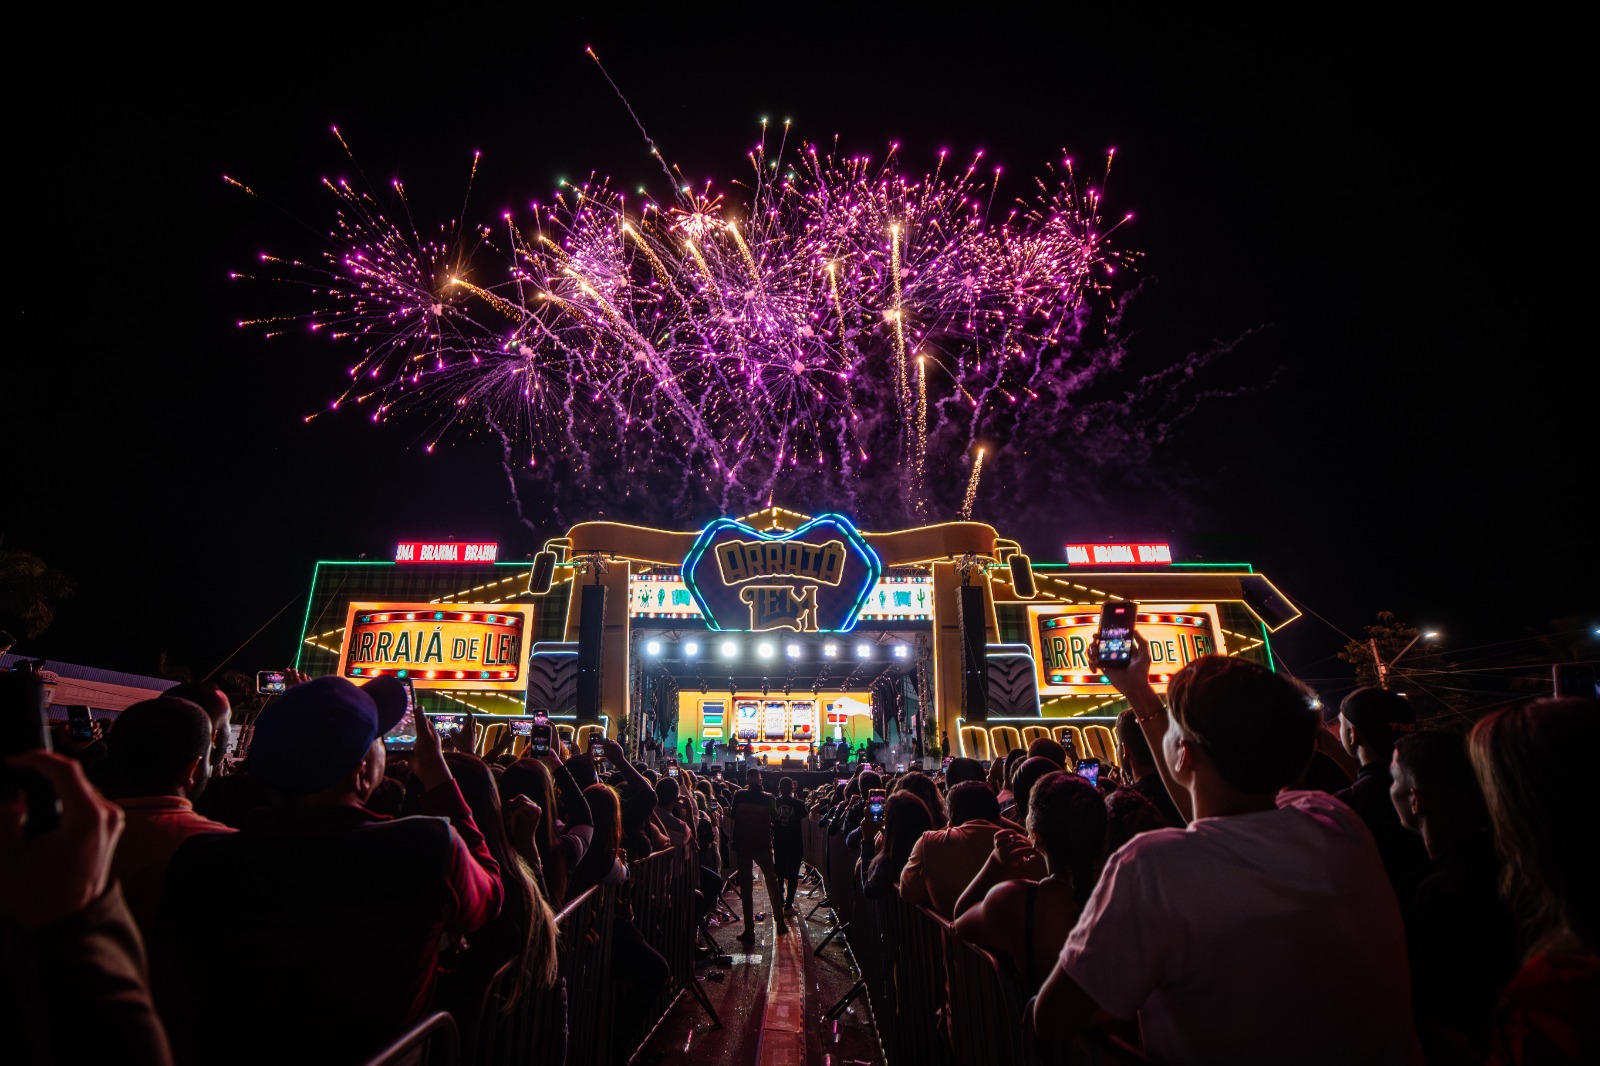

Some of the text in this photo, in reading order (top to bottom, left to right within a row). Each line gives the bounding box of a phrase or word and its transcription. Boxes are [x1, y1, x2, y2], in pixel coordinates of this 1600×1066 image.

[420, 544, 458, 560] BRAHMA
[717, 541, 845, 585] ARRAIÁ
[349, 626, 444, 663] ARRAIÁ
[452, 638, 479, 661] DE
[1150, 639, 1177, 664] DE
